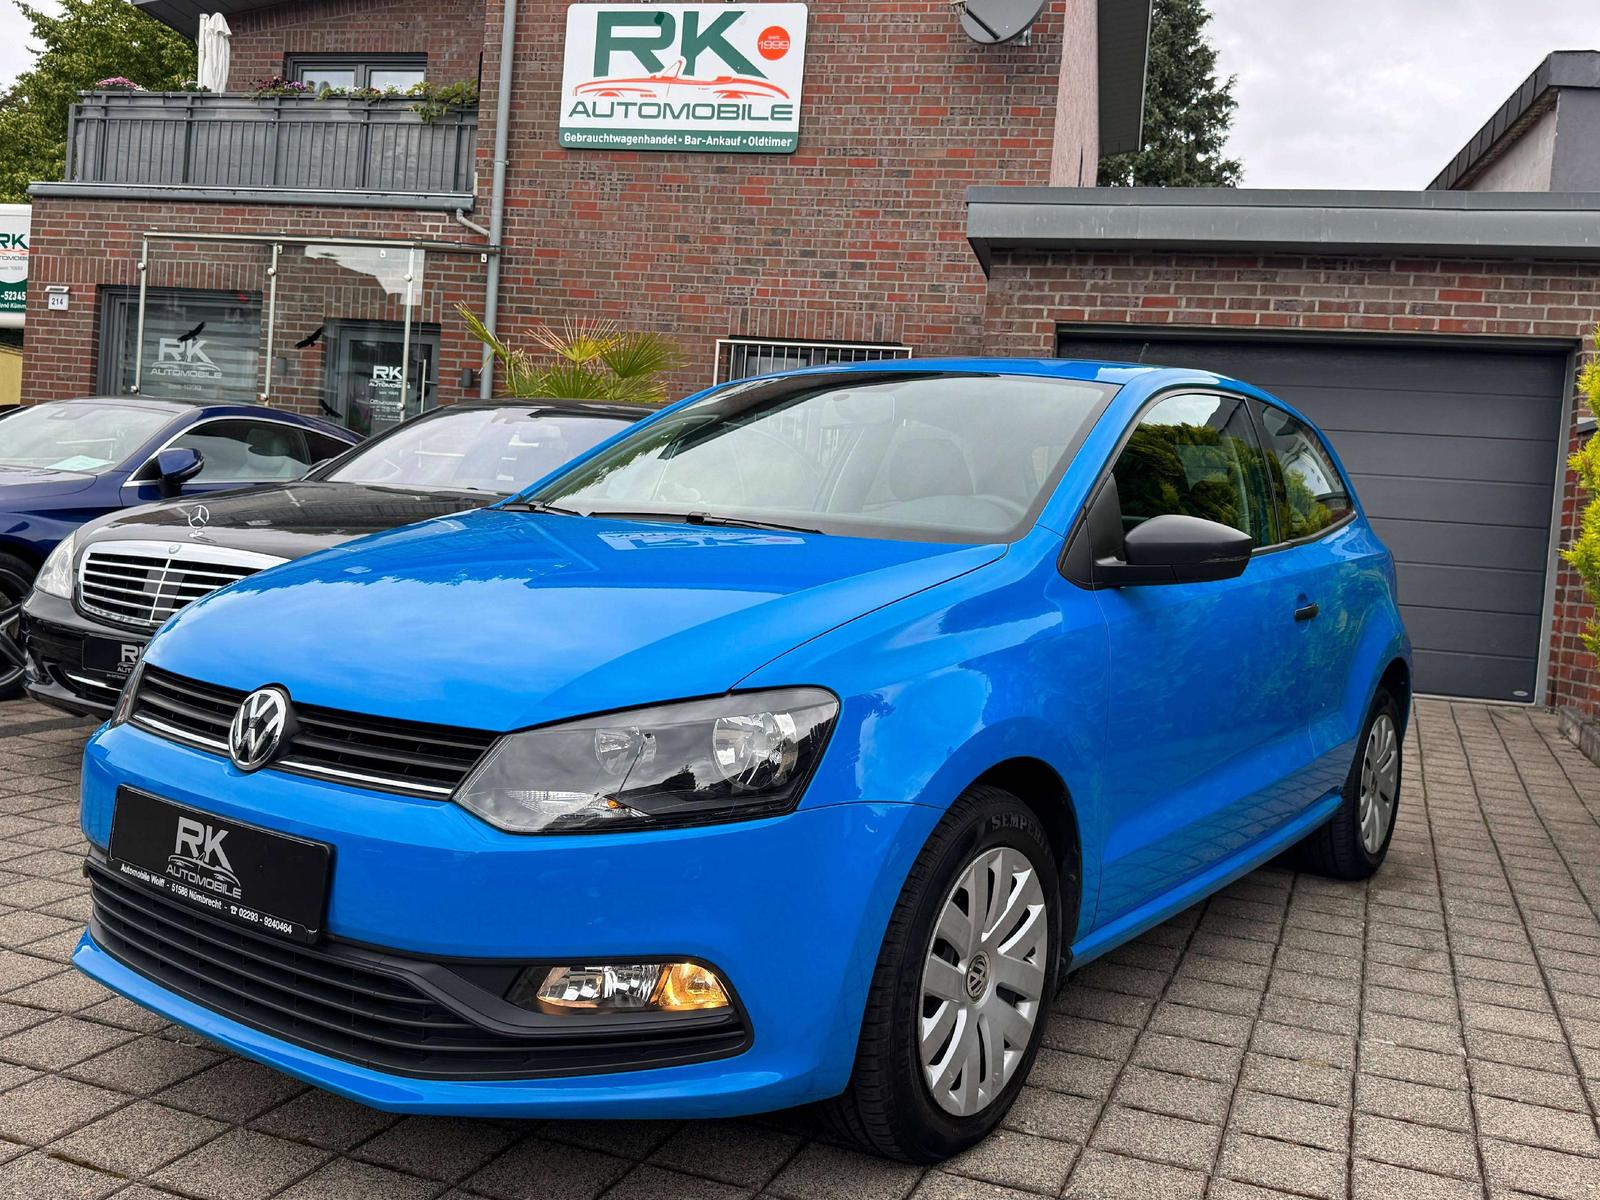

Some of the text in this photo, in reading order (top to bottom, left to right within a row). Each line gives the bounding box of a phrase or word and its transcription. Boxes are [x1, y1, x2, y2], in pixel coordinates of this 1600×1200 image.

[593, 11, 769, 79] RK
[758, 40, 790, 50] 1999
[568, 101, 794, 121] AUTOMOBILE
[564, 132, 793, 147] Gebrauchtwagenhandel Bar-Ankauf Oldtimer
[51, 297, 64, 306] 214
[158, 337, 215, 364] RK
[150, 368, 223, 379] AUTOMOBILE
[373, 365, 403, 380] RK
[174, 816, 234, 873] RK
[165, 864, 242, 900] AUTOMOBILE
[120, 863, 150, 882] Automobile
[238, 908, 259, 922] 02293
[264, 916, 293, 934] 9240464
